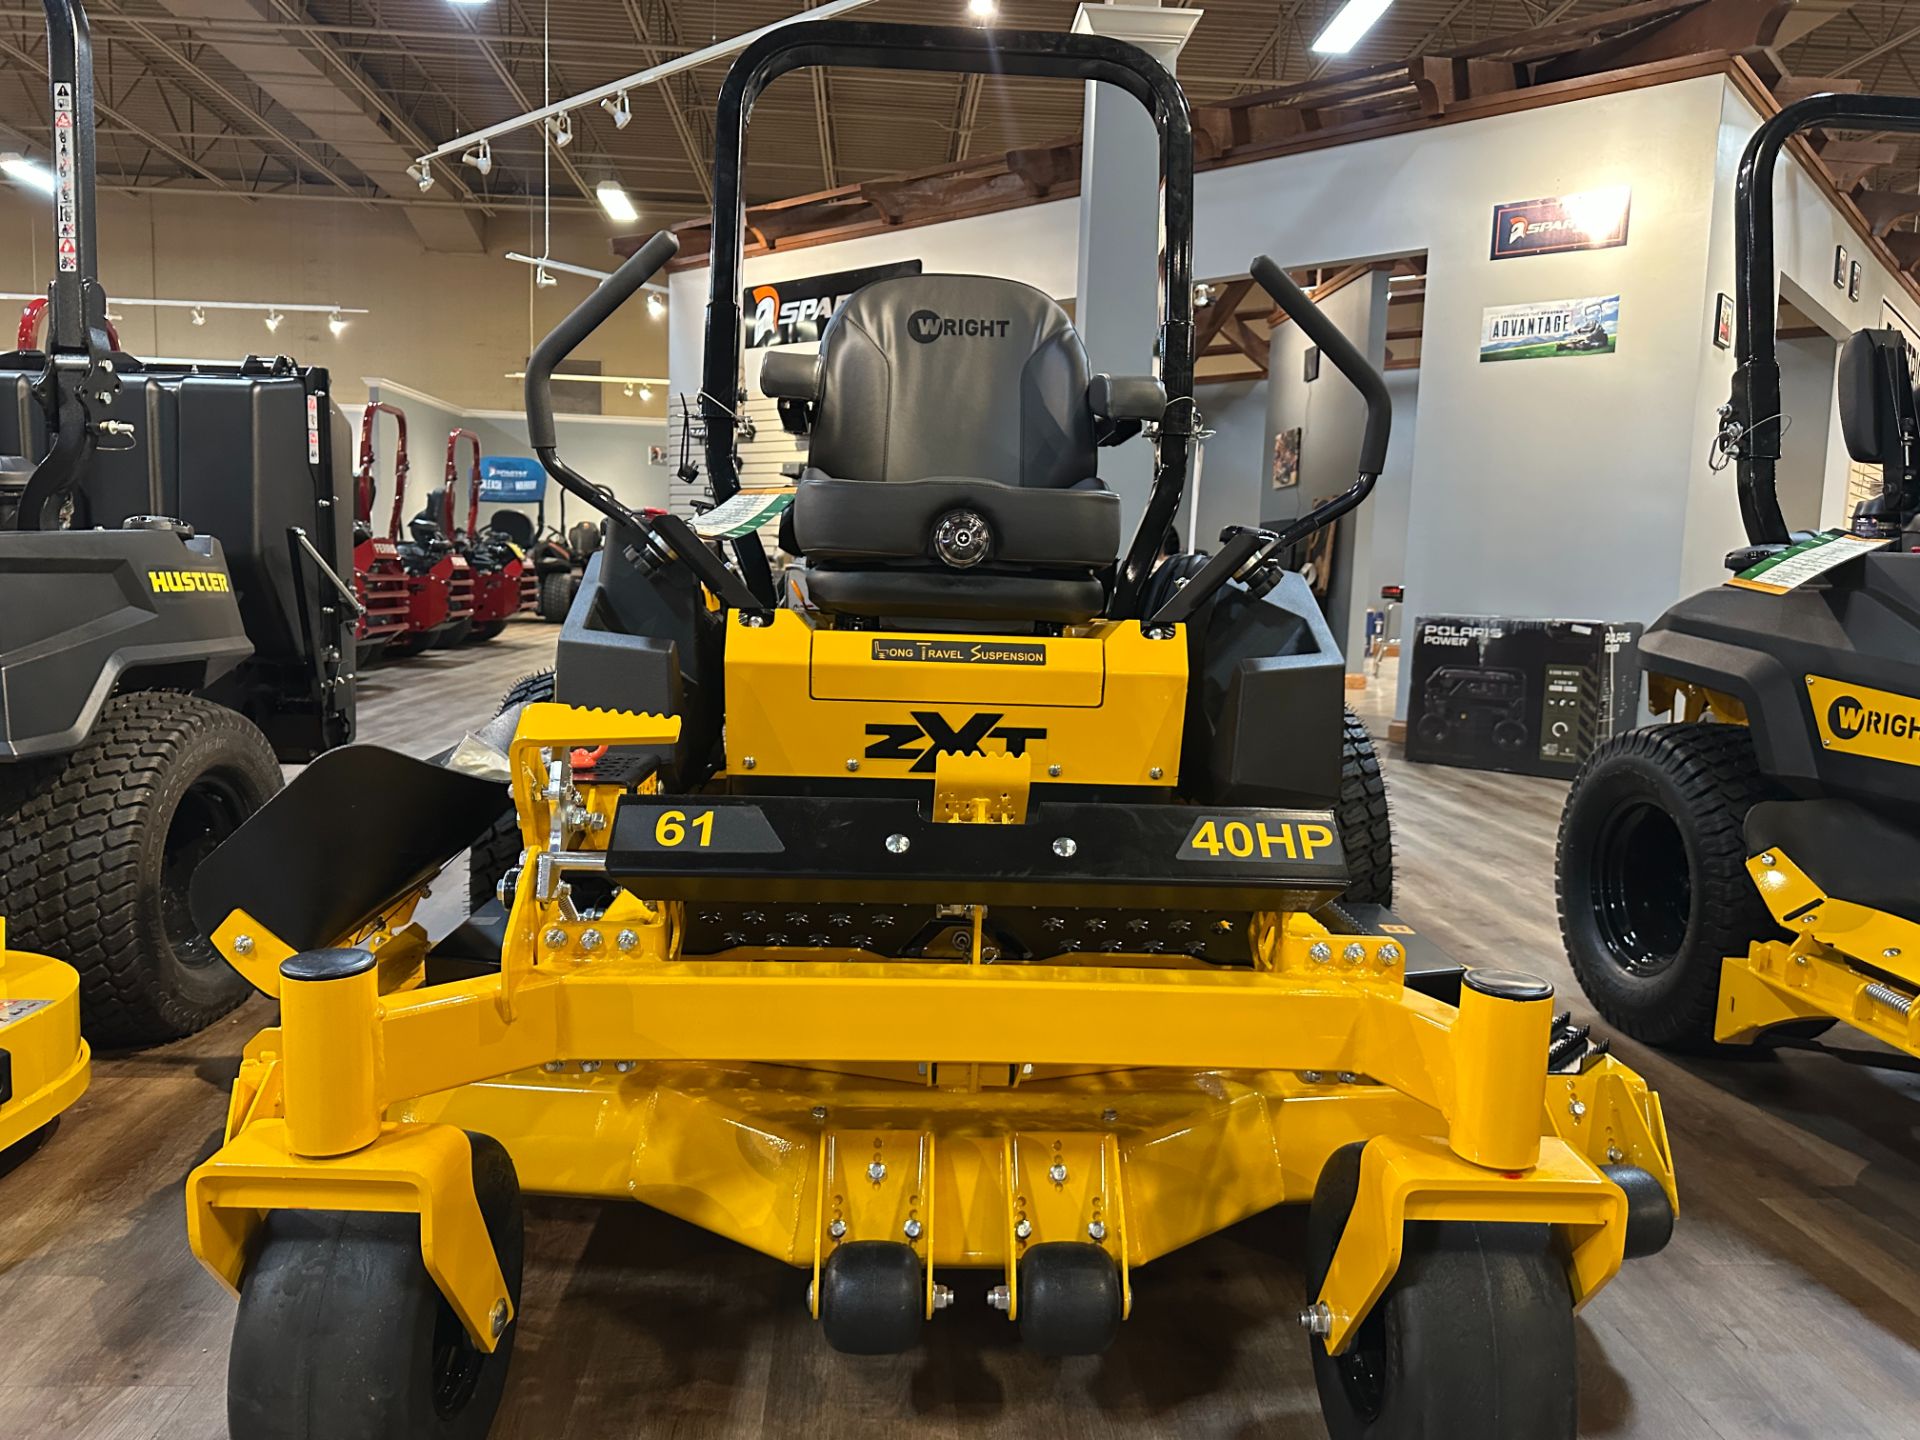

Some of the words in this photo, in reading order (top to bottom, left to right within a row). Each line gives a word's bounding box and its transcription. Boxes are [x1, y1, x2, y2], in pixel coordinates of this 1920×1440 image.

[779, 293, 853, 325] SPA
[908, 311, 1010, 342] WRIGHT
[1492, 314, 1570, 338] ADVANTAGE
[148, 571, 229, 592] HUSTLER
[1424, 624, 1503, 638] POLARIS
[1424, 635, 1469, 647] POWER
[875, 641, 914, 659] LONG
[916, 642, 964, 660] TRAVEL
[970, 644, 1044, 662] SUSPENSION
[1830, 700, 1920, 740] WRIGH
[865, 711, 1047, 773] ZXT
[655, 810, 714, 847] 61
[1191, 821, 1334, 860] 40HP
